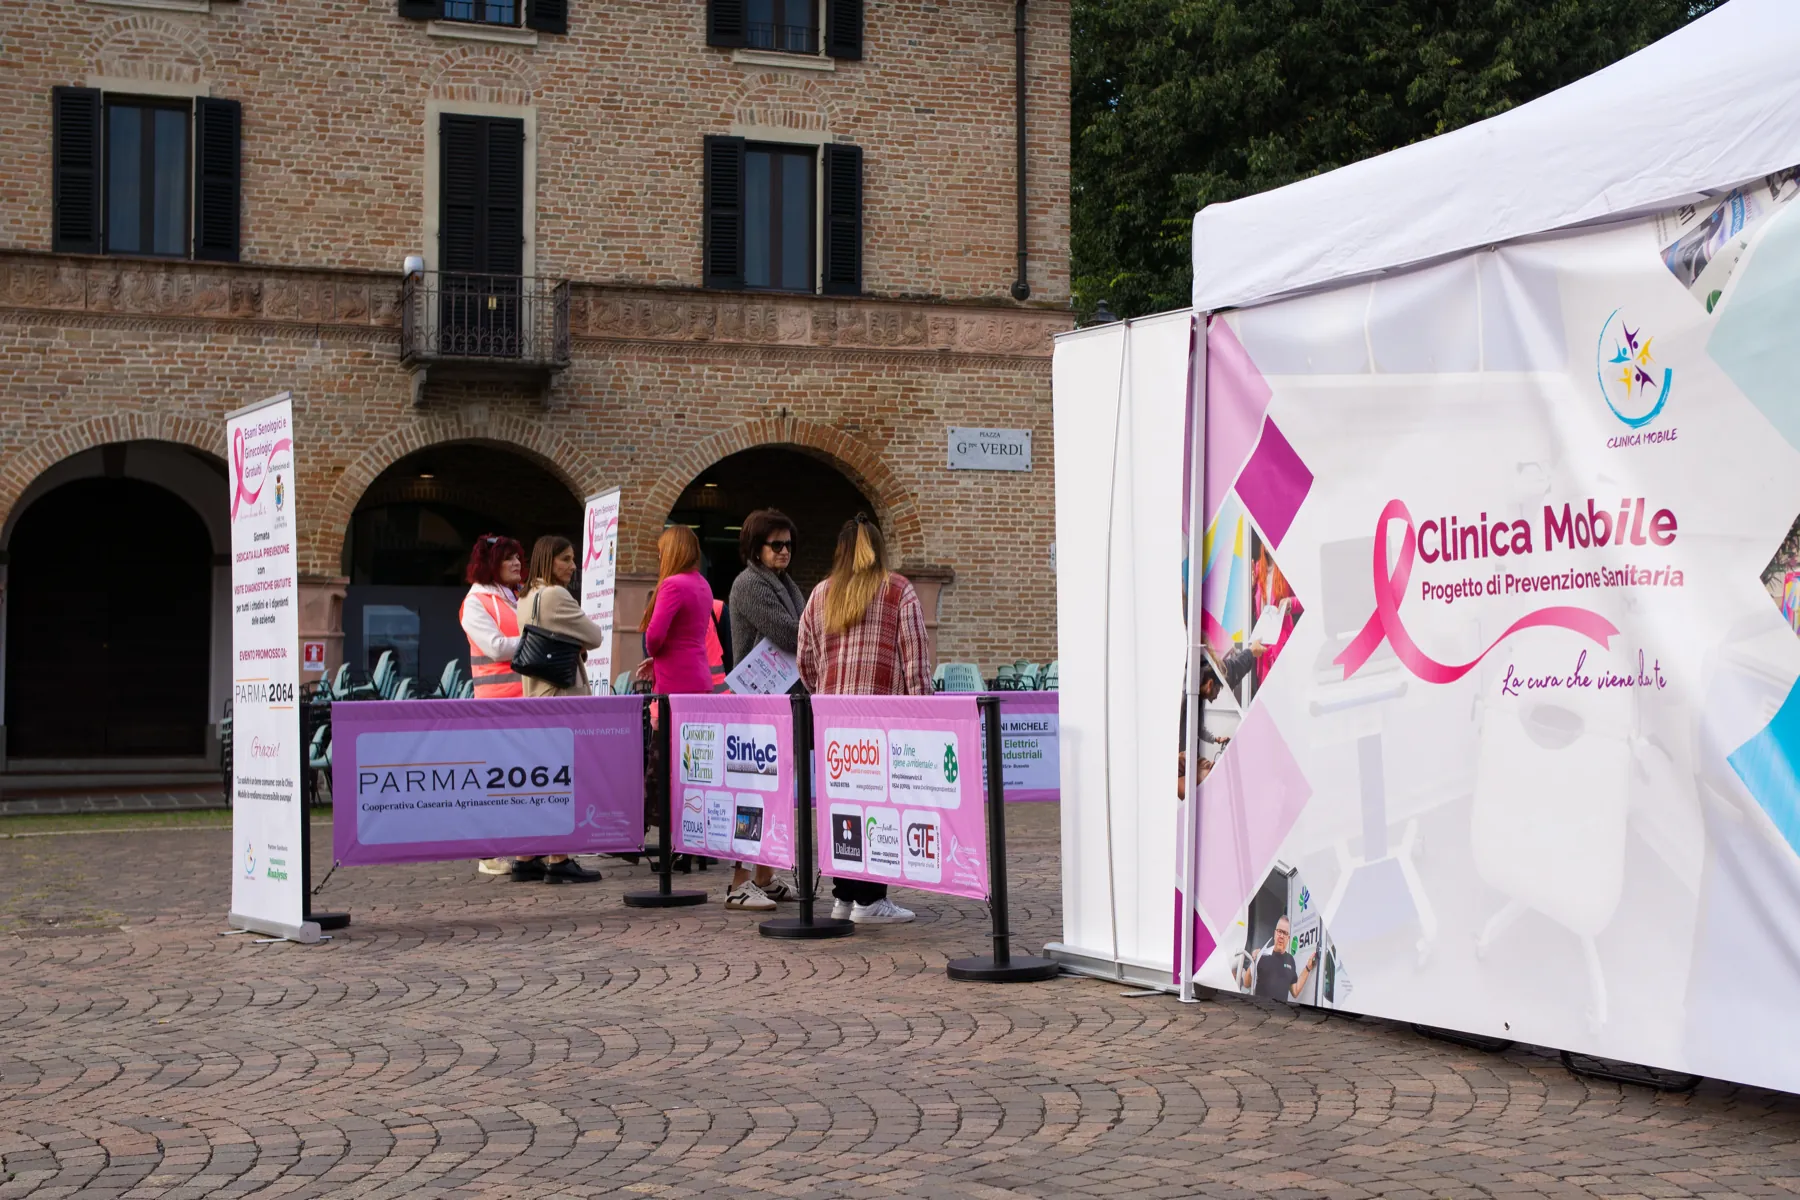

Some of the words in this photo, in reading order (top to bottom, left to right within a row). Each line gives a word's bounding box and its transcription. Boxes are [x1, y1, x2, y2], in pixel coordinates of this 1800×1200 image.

[244, 424, 258, 440] Esami
[258, 416, 282, 435] Senologici
[283, 418, 286, 428] e
[1606, 434, 1641, 449] CLINICA
[1643, 428, 1678, 444] MOBILE
[245, 440, 272, 459] Ginecologici
[980, 443, 1023, 455] VERDI
[1418, 512, 1532, 564] Clinica
[1544, 498, 1678, 552] Mobile
[1422, 577, 1483, 604] Progetto
[1486, 574, 1501, 595] di
[1505, 568, 1600, 594] Prevenzione
[1601, 564, 1684, 587] Sanitaria
[240, 650, 255, 661] EVENTO
[1502, 664, 1524, 696] La
[1527, 674, 1563, 689] cura
[1566, 649, 1592, 689] che
[1598, 670, 1635, 689] viene
[1637, 648, 1653, 687] da
[1653, 659, 1667, 690] te
[596, 727, 630, 736] PARTNER
[683, 724, 715, 740] Consorzio
[1010, 722, 1048, 731] MICHELE
[251, 736, 280, 758] Grazie!
[726, 735, 777, 770] Sintec
[892, 742, 901, 756] bio
[903, 744, 915, 756] line
[1004, 739, 1038, 748] Elettrici
[844, 739, 879, 772] gobbi
[1002, 750, 1042, 760] ndustriali
[694, 761, 713, 779] Parma
[362, 802, 414, 813] Cooperativa
[416, 800, 453, 809] Casearia
[454, 798, 508, 809] Agrinascente
[530, 796, 545, 805] Agr.
[548, 795, 570, 804] Coop
[876, 834, 898, 845] CREMONA
[907, 822, 935, 859] GTE
[835, 842, 860, 856] Dallatana
[1299, 926, 1318, 948] SATI
